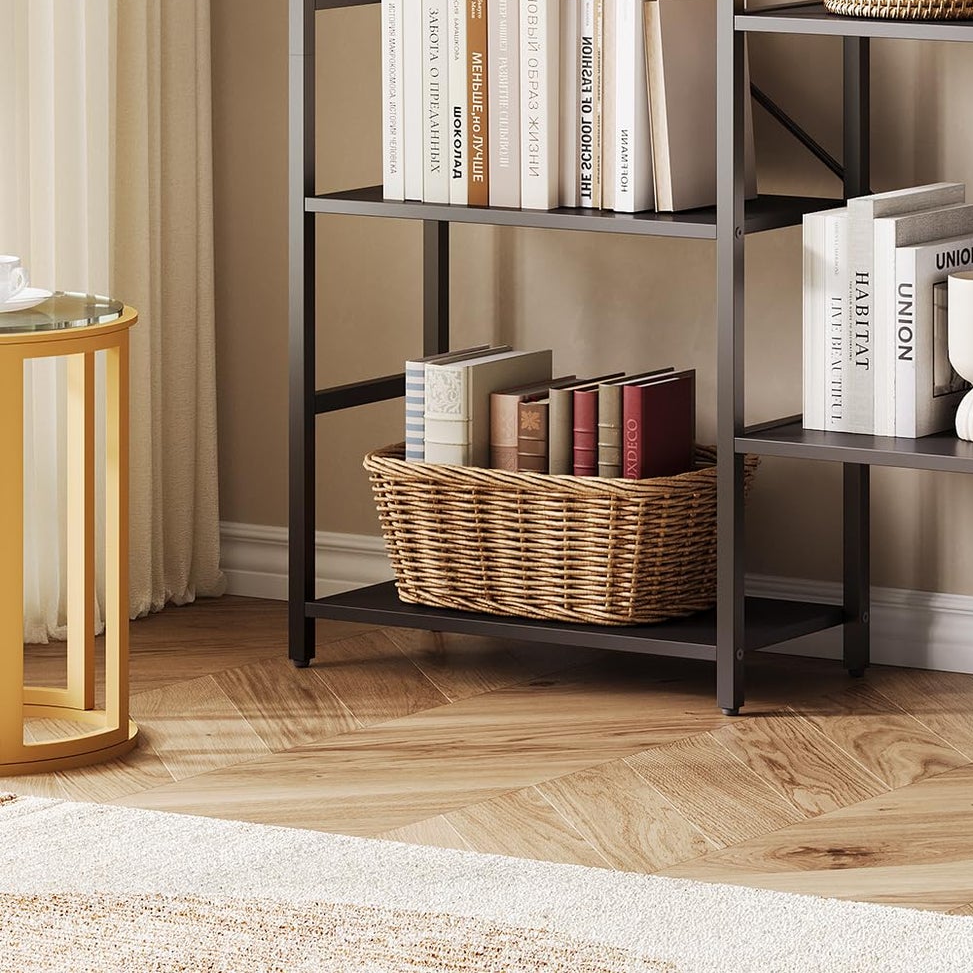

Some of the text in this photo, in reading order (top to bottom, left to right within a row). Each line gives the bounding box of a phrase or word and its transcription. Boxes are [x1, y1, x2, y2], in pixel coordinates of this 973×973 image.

[388, 3, 397, 36] ИСТОРИЯ
[428, 7, 441, 173] ЗАБОТА О ПРЕДАННЫХ
[527, 58, 540, 110] ОБРАЗ
[388, 101, 397, 135] ИСТОРИЯ
[453, 106, 463, 179] ШОКОЛАД
[527, 116, 540, 178] ЖИЗНИ
[388, 137, 397, 174] ЧЕЛОВЕКА
[472, 134, 484, 182] ЛУЧШЕ
[855, 272, 870, 371] HABITAT
[897, 283, 913, 361] UNION
[831, 297, 843, 424] LIVE BEAUTIFUL
[626, 418, 640, 479] UXDECO
